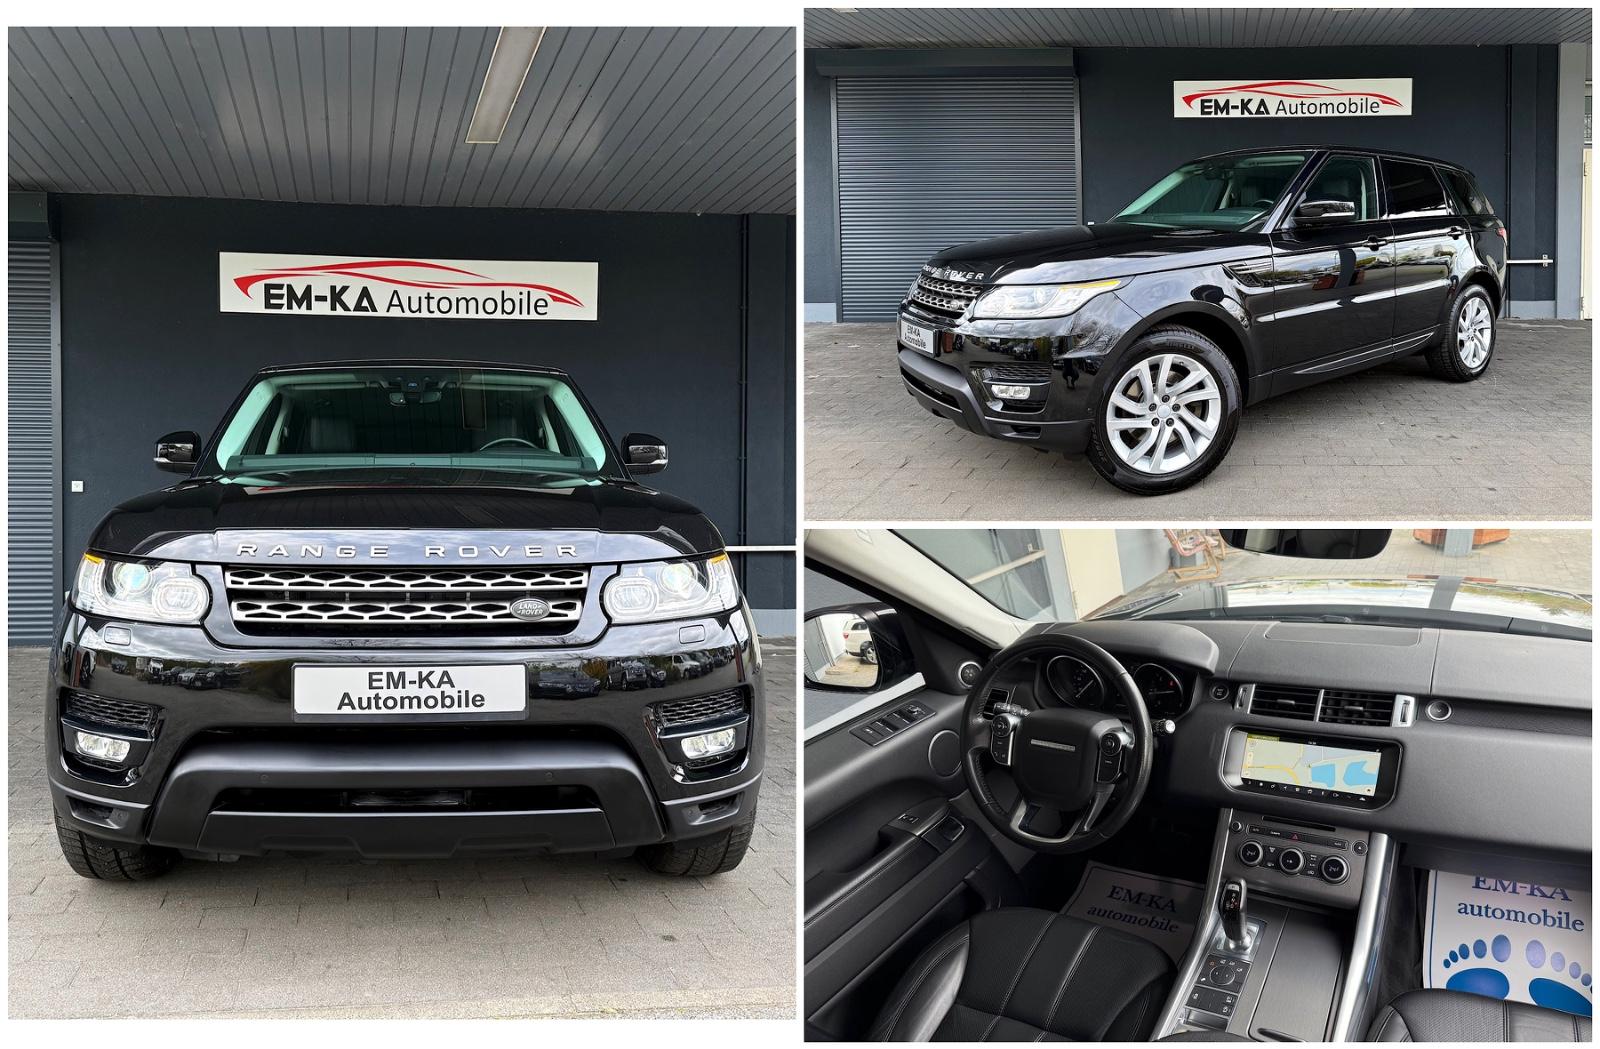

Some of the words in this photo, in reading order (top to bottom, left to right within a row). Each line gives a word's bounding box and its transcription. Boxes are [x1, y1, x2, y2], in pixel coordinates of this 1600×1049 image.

[1200, 98, 1270, 116] EM-KA
[1275, 97, 1380, 115] Automobile
[263, 282, 379, 313] EM-KA
[386, 288, 549, 316] Automobile
[236, 543, 389, 558] RANGE
[424, 544, 578, 558] ROVER
[519, 602, 538, 610] LAND
[367, 670, 456, 690] EM-KA
[336, 690, 486, 711] Automobile
[1106, 885, 1177, 913] EM-KA
[1086, 905, 1180, 934] automobile
[1457, 902, 1585, 932] automobile
